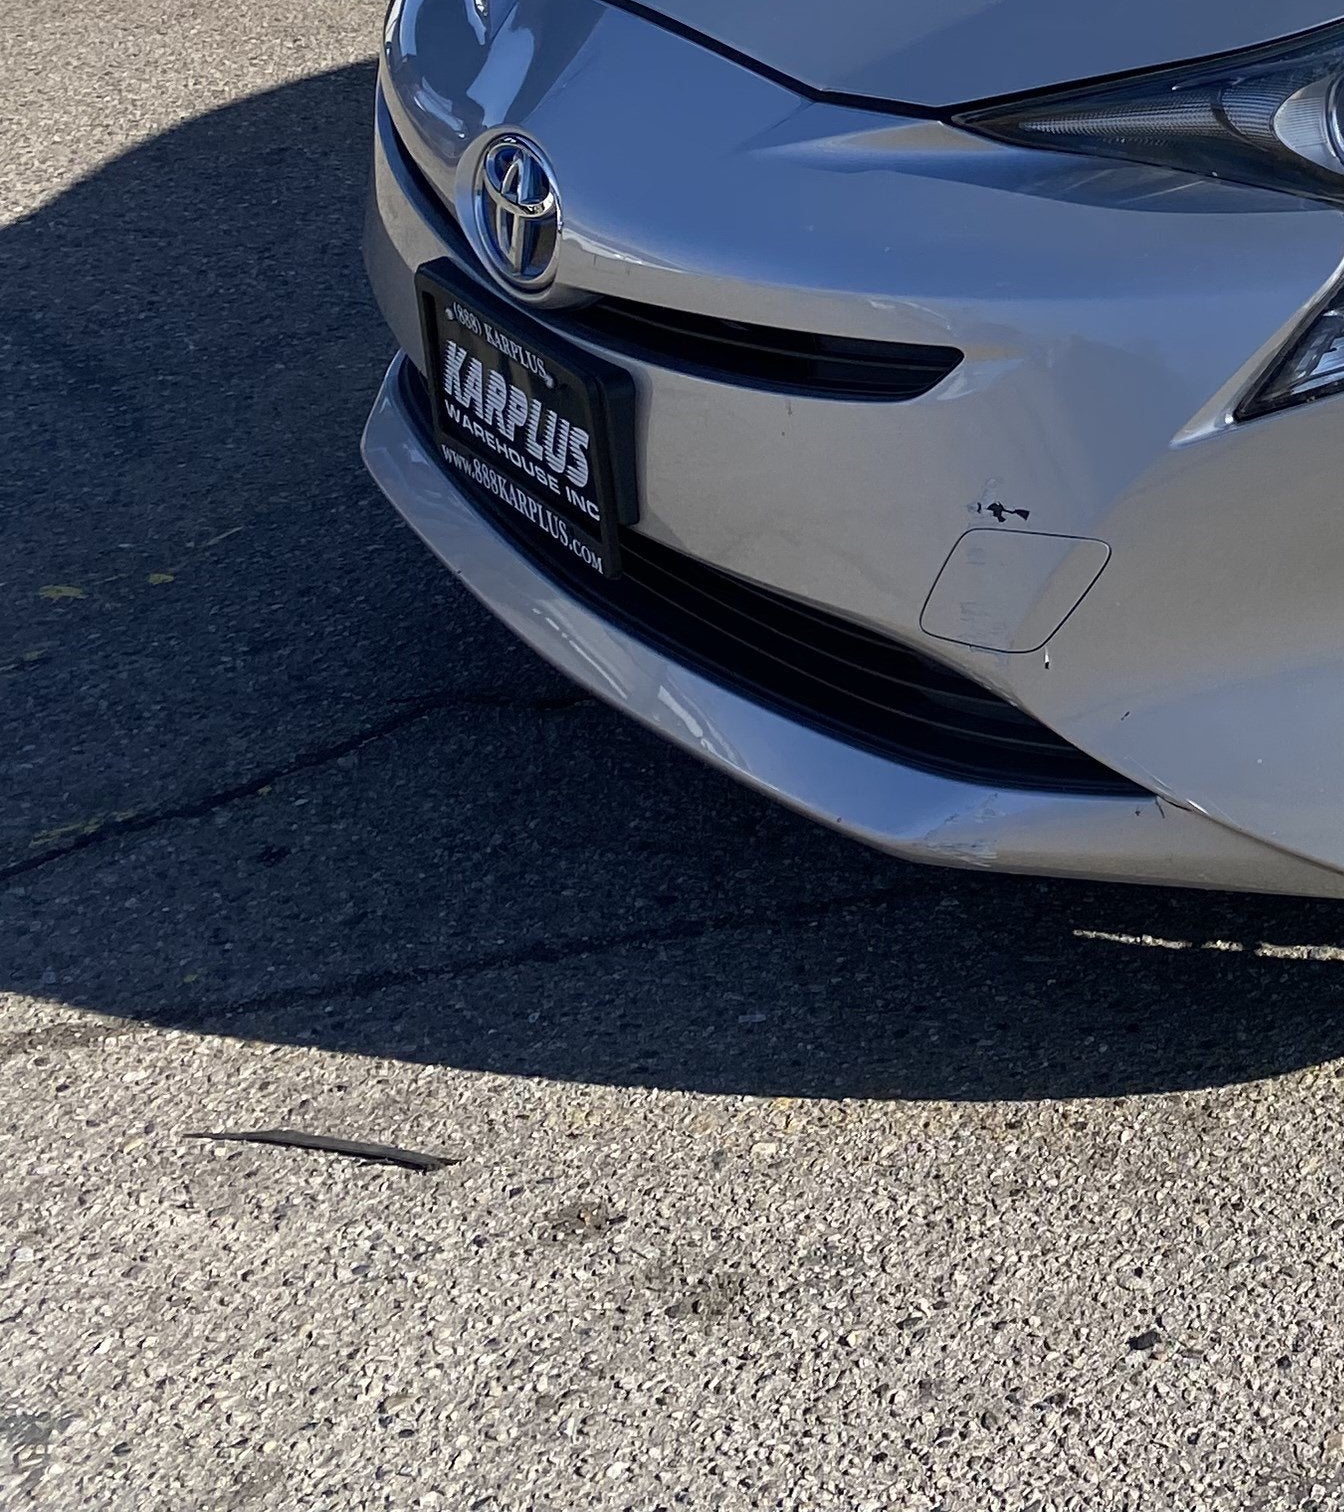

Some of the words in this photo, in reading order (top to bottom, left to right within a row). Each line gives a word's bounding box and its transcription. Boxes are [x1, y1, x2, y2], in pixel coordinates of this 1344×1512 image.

[453, 301, 482, 336] (888)
[484, 322, 548, 377] KARPLUS
[443, 340, 590, 488] KARPLUS
[444, 399, 561, 495] WAREHOUSE
[565, 485, 601, 522] INC
